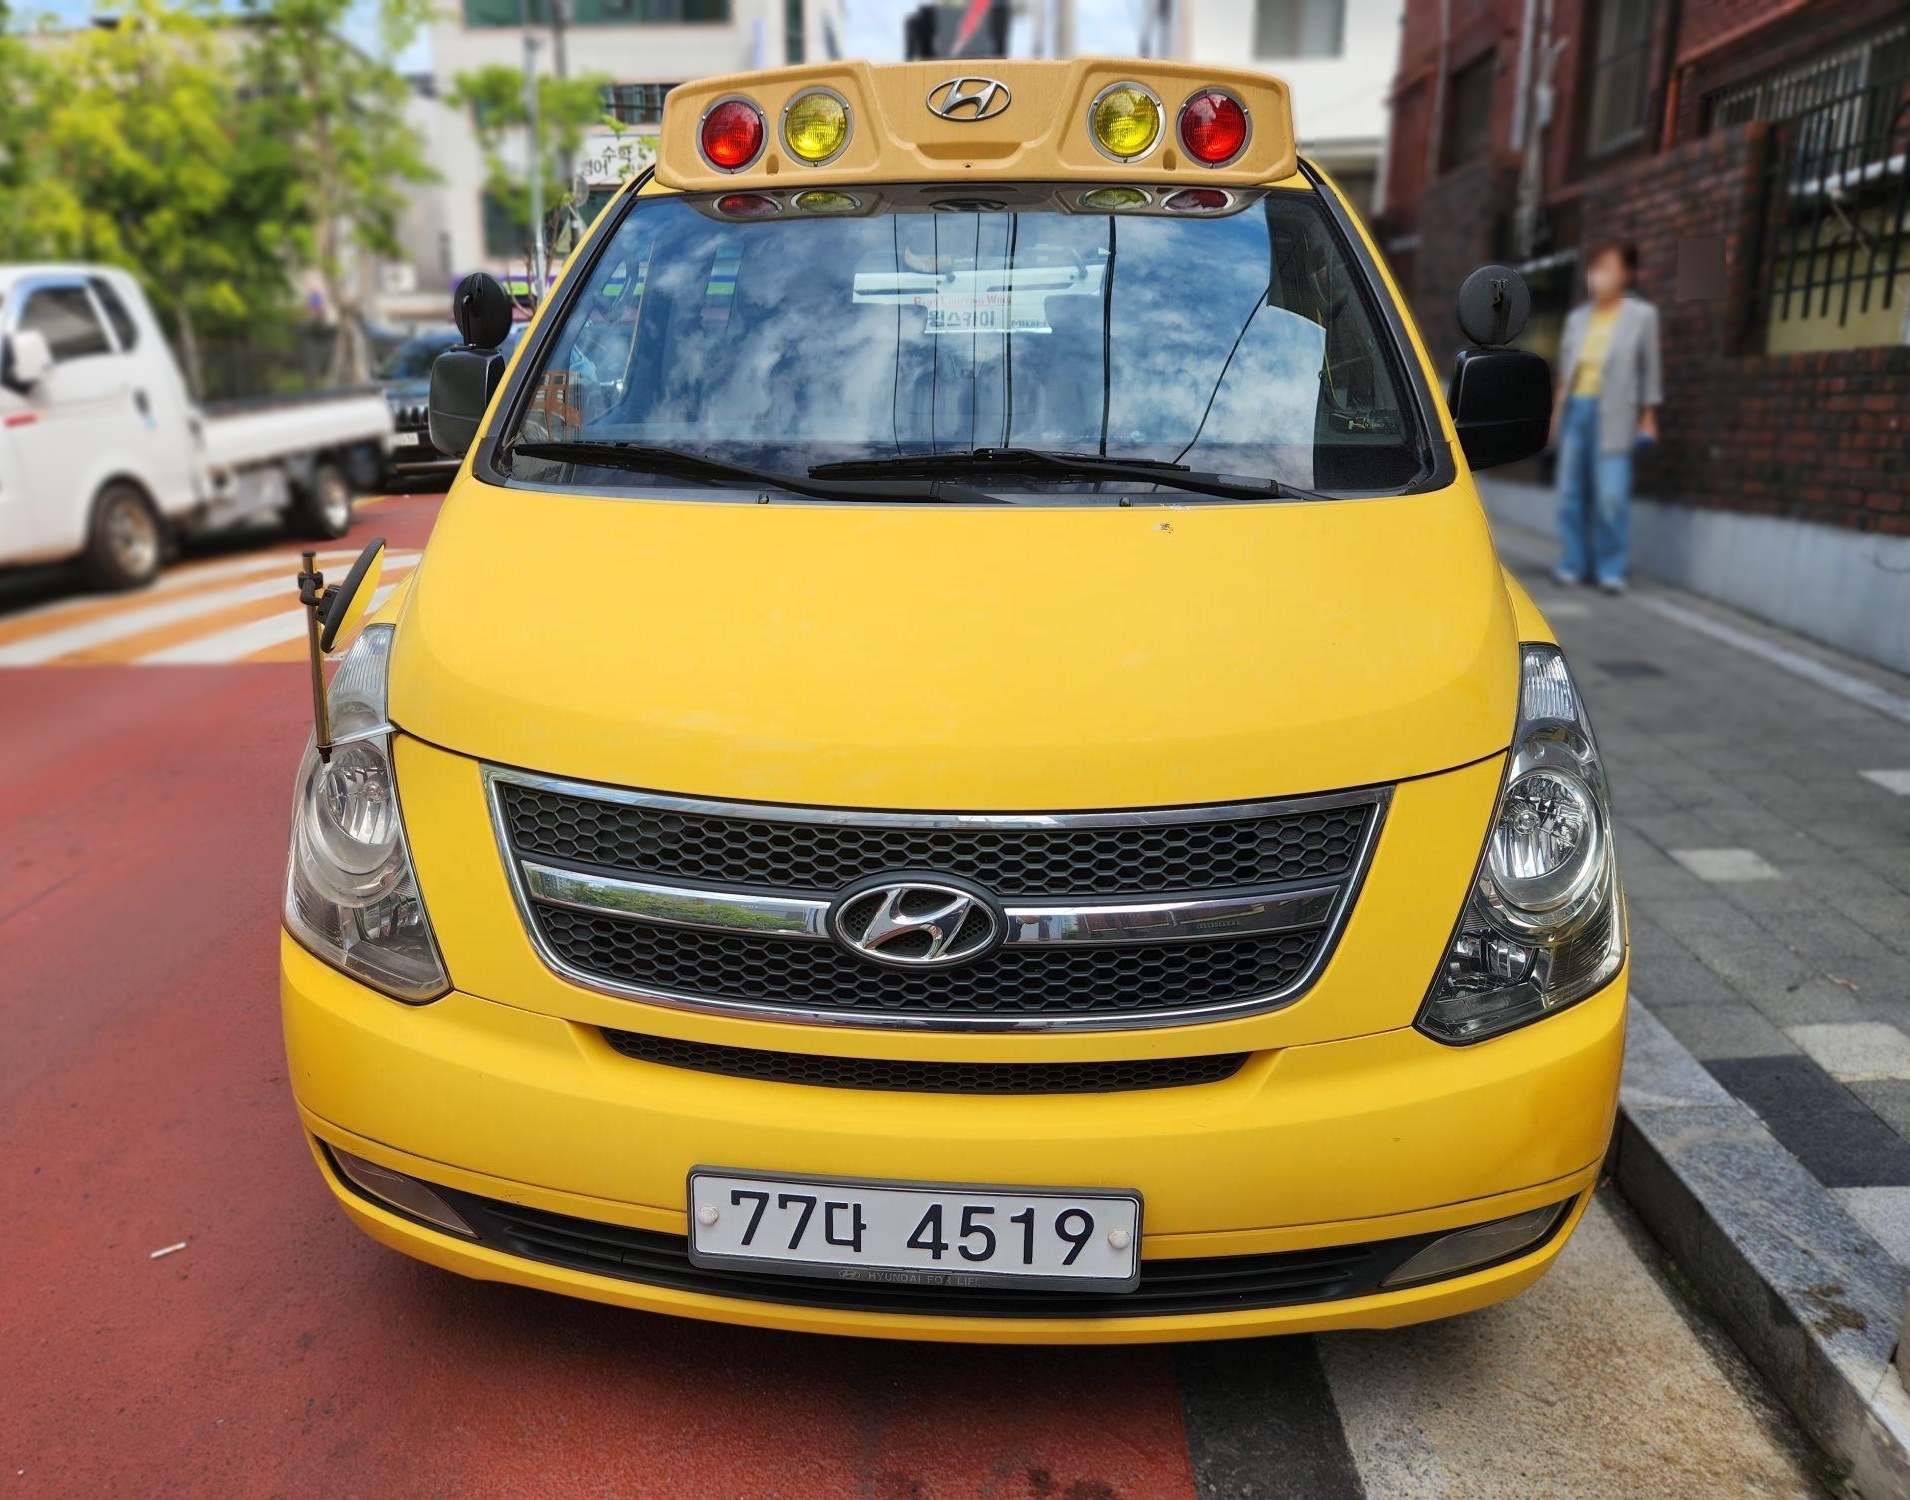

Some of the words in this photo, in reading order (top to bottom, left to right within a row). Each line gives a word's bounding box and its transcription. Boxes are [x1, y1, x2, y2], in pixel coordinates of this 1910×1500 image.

[730, 1189, 867, 1252] 77다
[906, 1203, 1095, 1266] 4519
[868, 1272, 921, 1284] HYUNDAI
